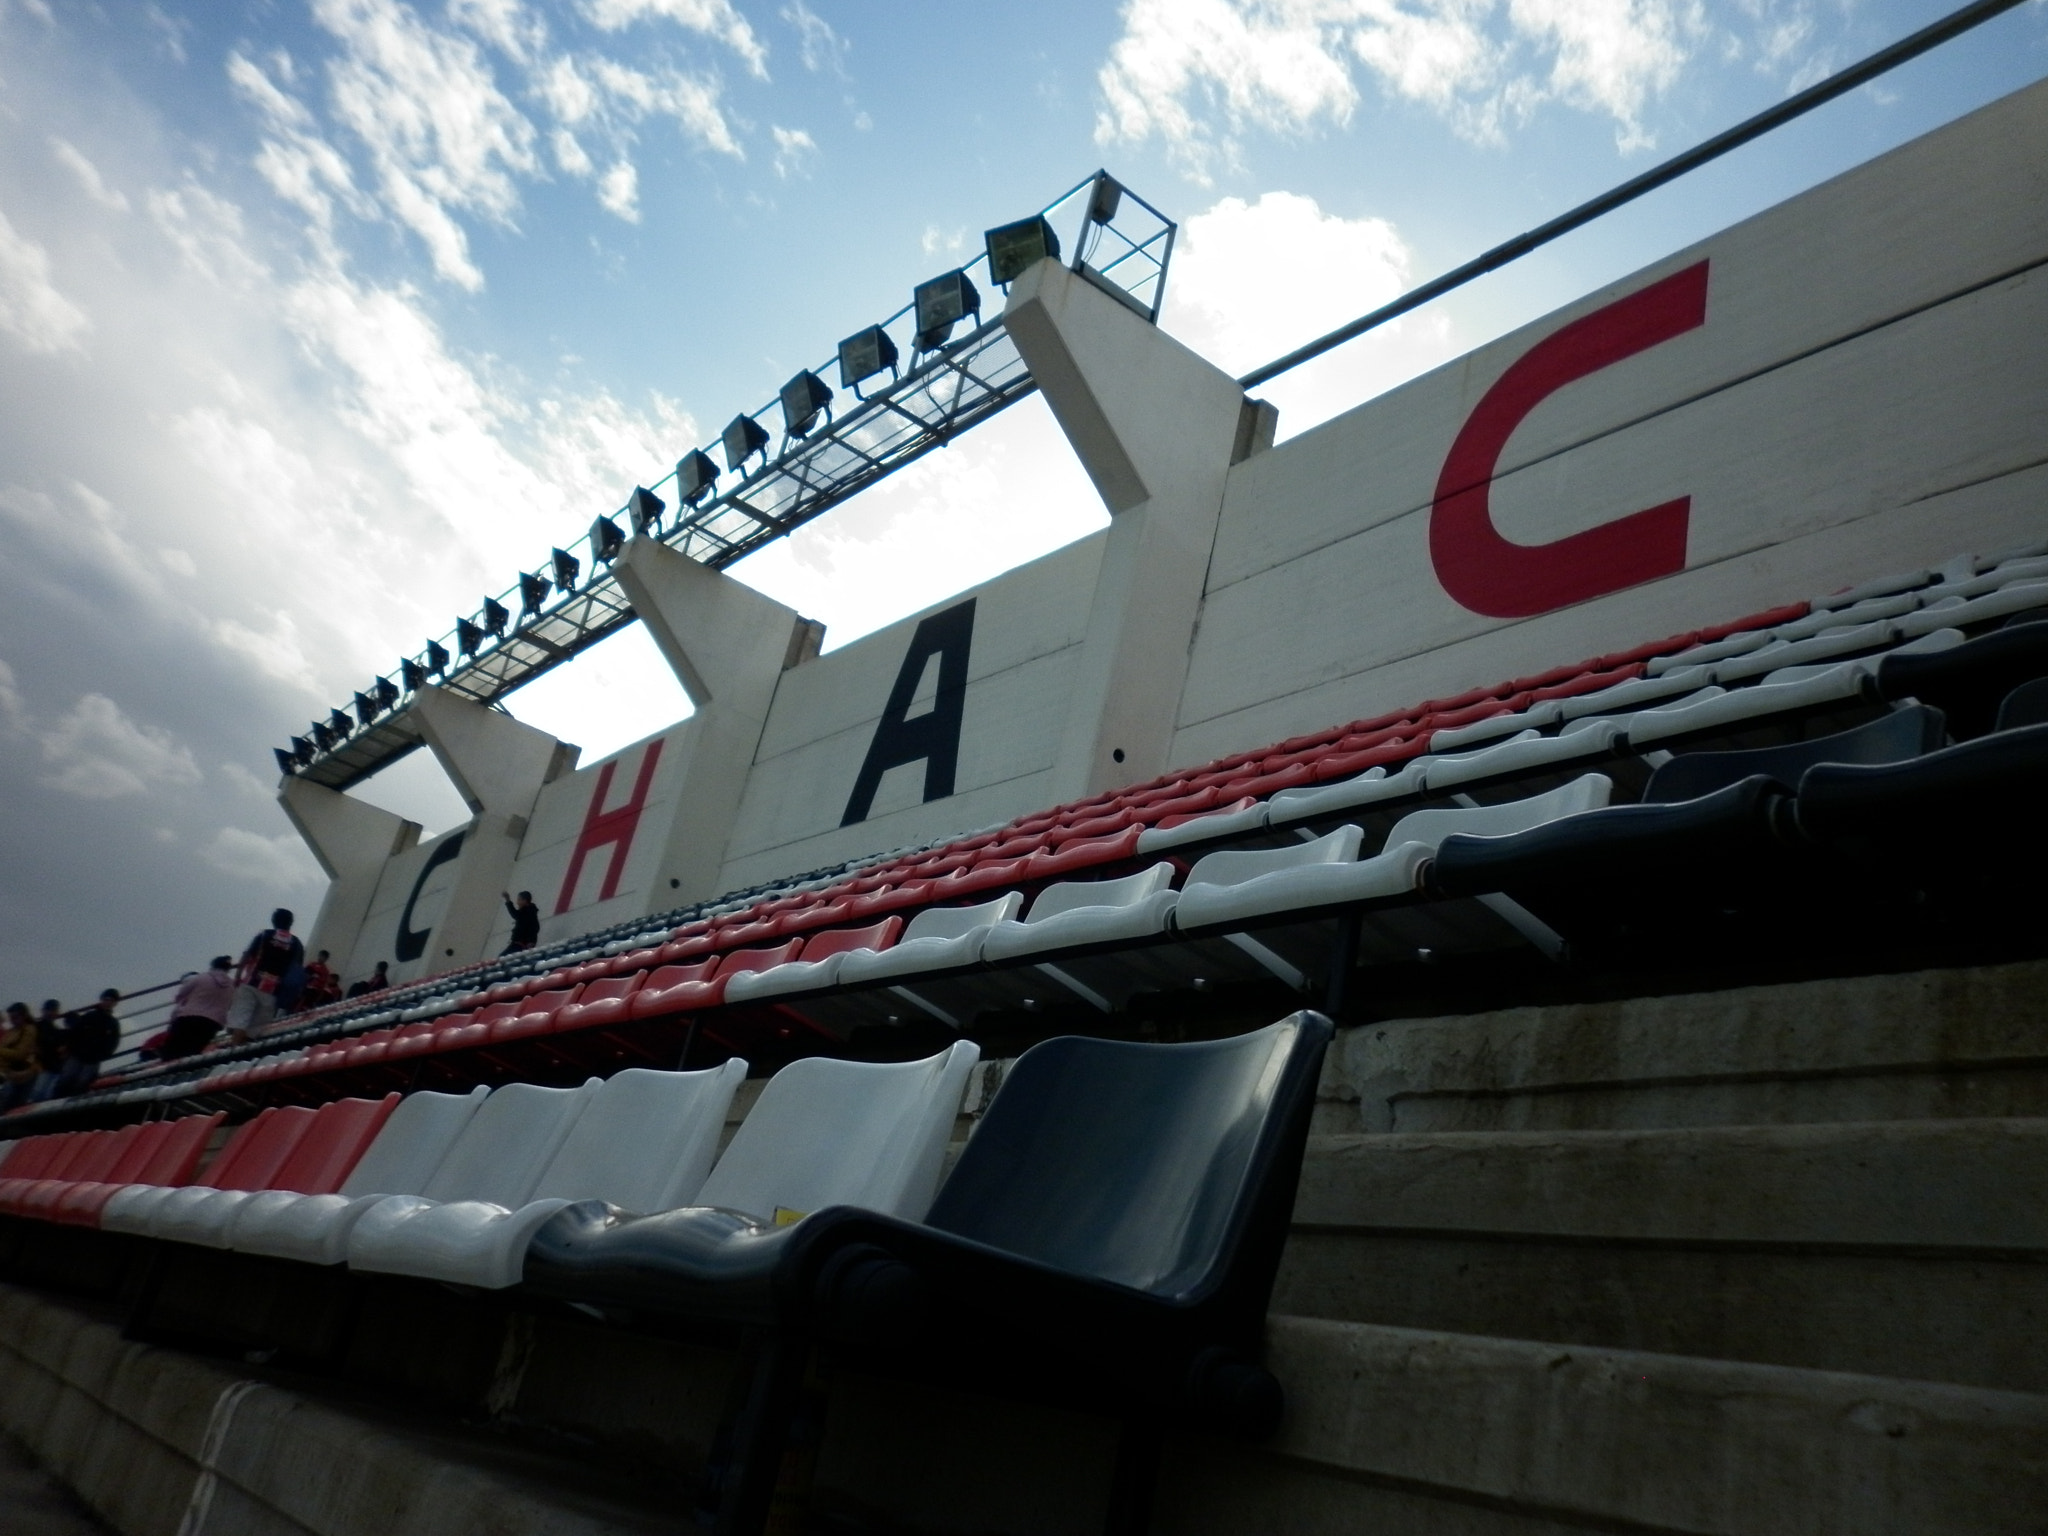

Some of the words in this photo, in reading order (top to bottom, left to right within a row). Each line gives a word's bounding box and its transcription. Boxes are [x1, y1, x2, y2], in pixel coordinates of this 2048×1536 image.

[554, 737, 665, 915] H
[839, 597, 977, 828] A
[1429, 257, 1710, 618] C
